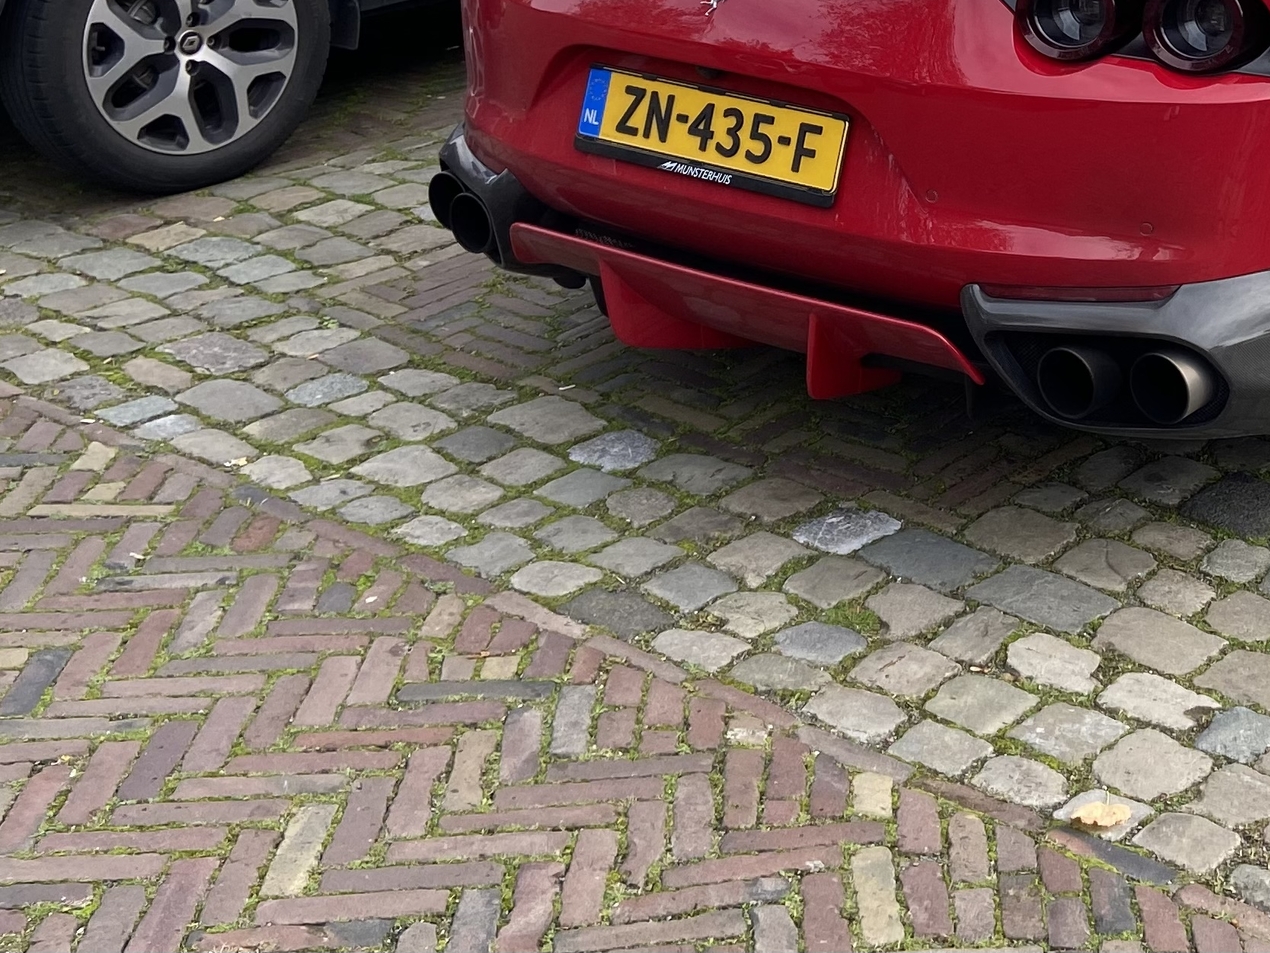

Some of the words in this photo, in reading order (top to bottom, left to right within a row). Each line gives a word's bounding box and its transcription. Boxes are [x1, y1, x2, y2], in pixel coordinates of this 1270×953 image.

[583, 108, 600, 126] NL
[615, 84, 824, 174] ZN-435-F
[673, 162, 733, 186] MUNSTERHUIS
